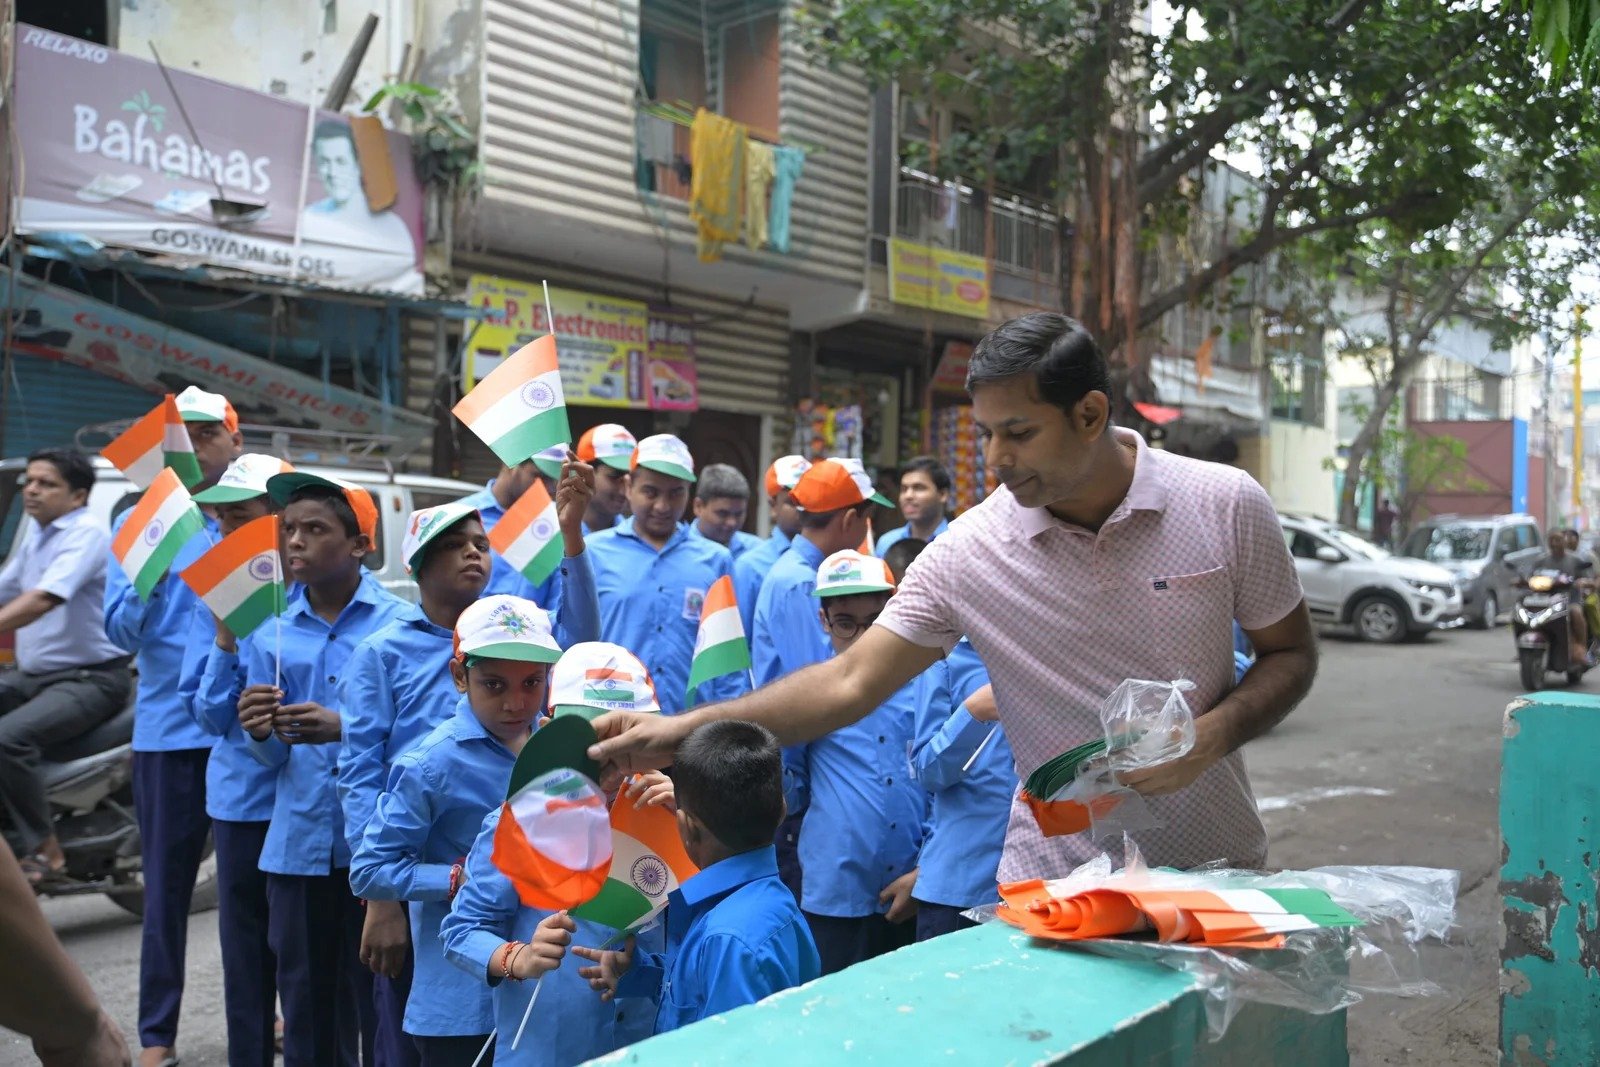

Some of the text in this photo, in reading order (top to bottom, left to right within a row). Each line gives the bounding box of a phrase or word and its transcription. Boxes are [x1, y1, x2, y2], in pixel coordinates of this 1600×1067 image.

[22, 27, 109, 65] RELAXO
[74, 104, 271, 195] Bahamas
[152, 228, 266, 262] GOSWAMI
[73, 311, 257, 387] GOSWAMI
